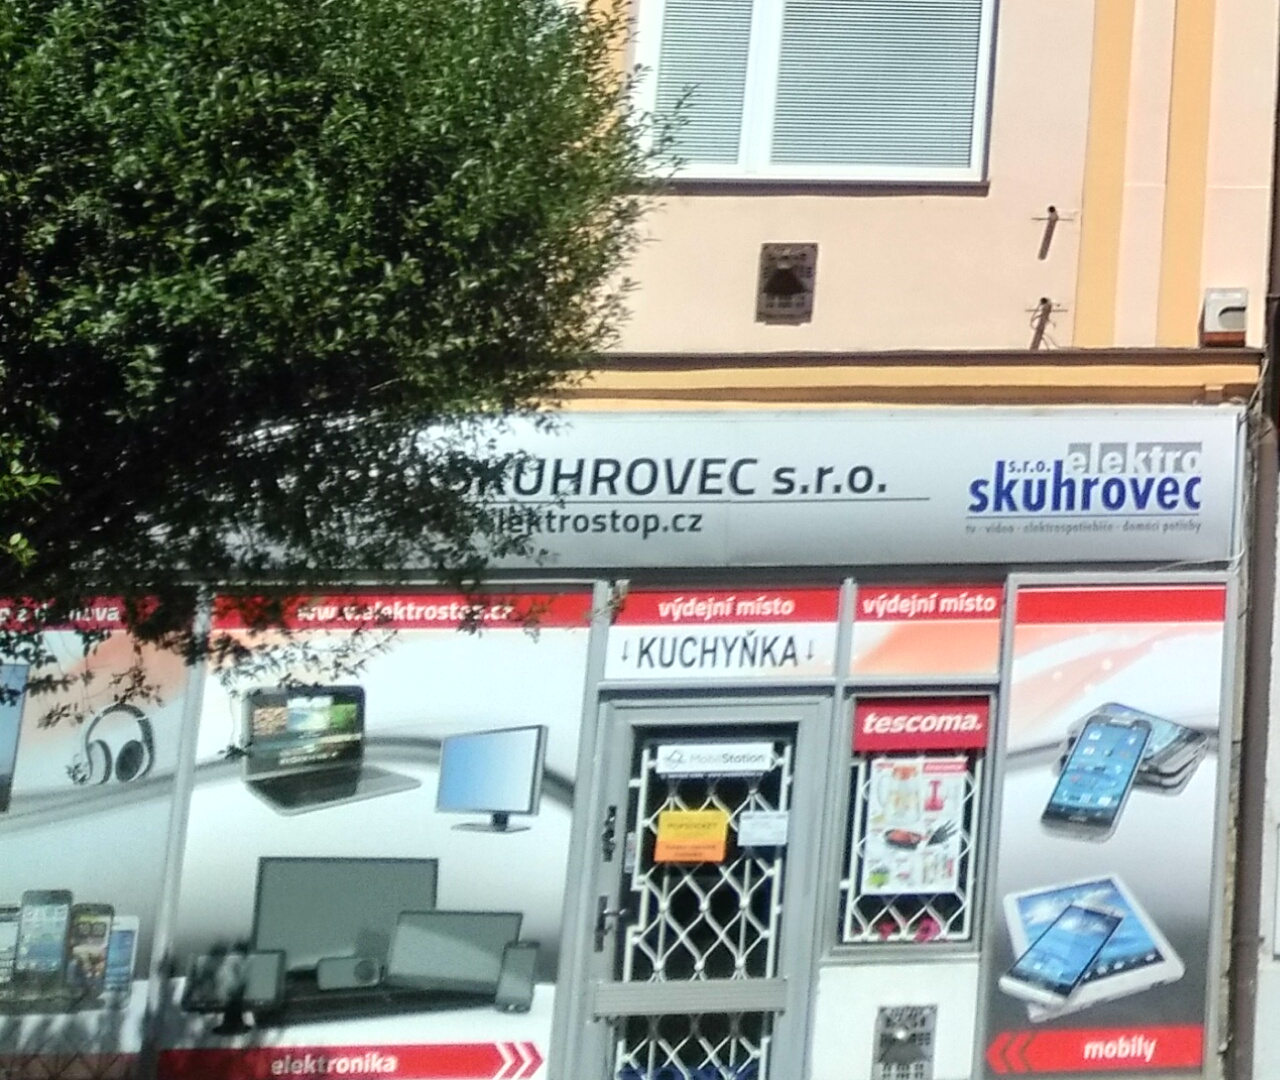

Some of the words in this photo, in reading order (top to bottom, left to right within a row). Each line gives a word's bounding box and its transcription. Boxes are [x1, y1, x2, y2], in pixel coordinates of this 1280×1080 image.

[1008, 458, 1051, 474] s.r.o.
[1067, 444, 1202, 473] elektro
[458, 458, 758, 496] KUHROVEC
[772, 465, 887, 495] s.r.o.
[968, 460, 1202, 513] skuhrovec
[658, 595, 736, 622] výdejní
[736, 594, 796, 616] místo
[862, 593, 938, 618] výdejní
[939, 592, 998, 613] místo
[636, 629, 799, 669] KUCHYŇKA
[1083, 1034, 1157, 1063] mobily
[271, 1052, 399, 1075] elektronika
